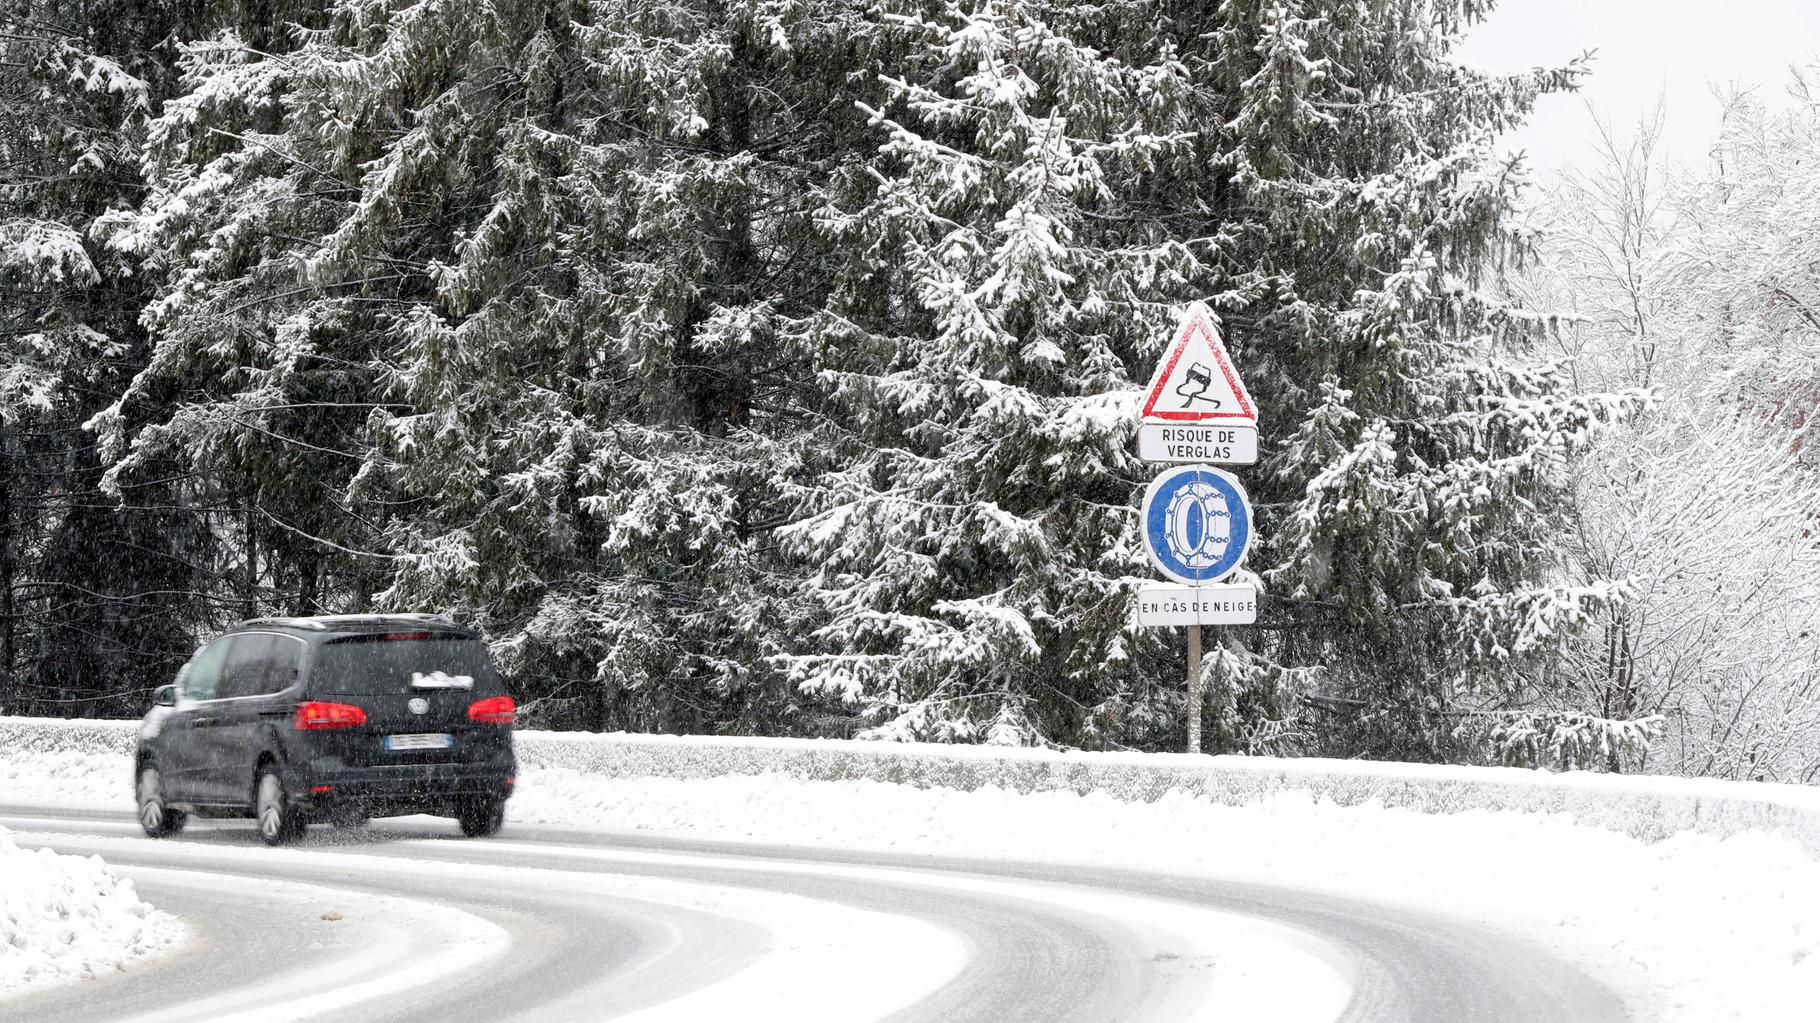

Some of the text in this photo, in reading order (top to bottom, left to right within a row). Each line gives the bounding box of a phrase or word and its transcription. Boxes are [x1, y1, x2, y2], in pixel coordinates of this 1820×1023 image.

[1162, 429, 1235, 443] RISQUE DE
[1167, 445, 1231, 459] VERGLAS
[1142, 602, 1253, 613] EN CAS DE NEIGE
